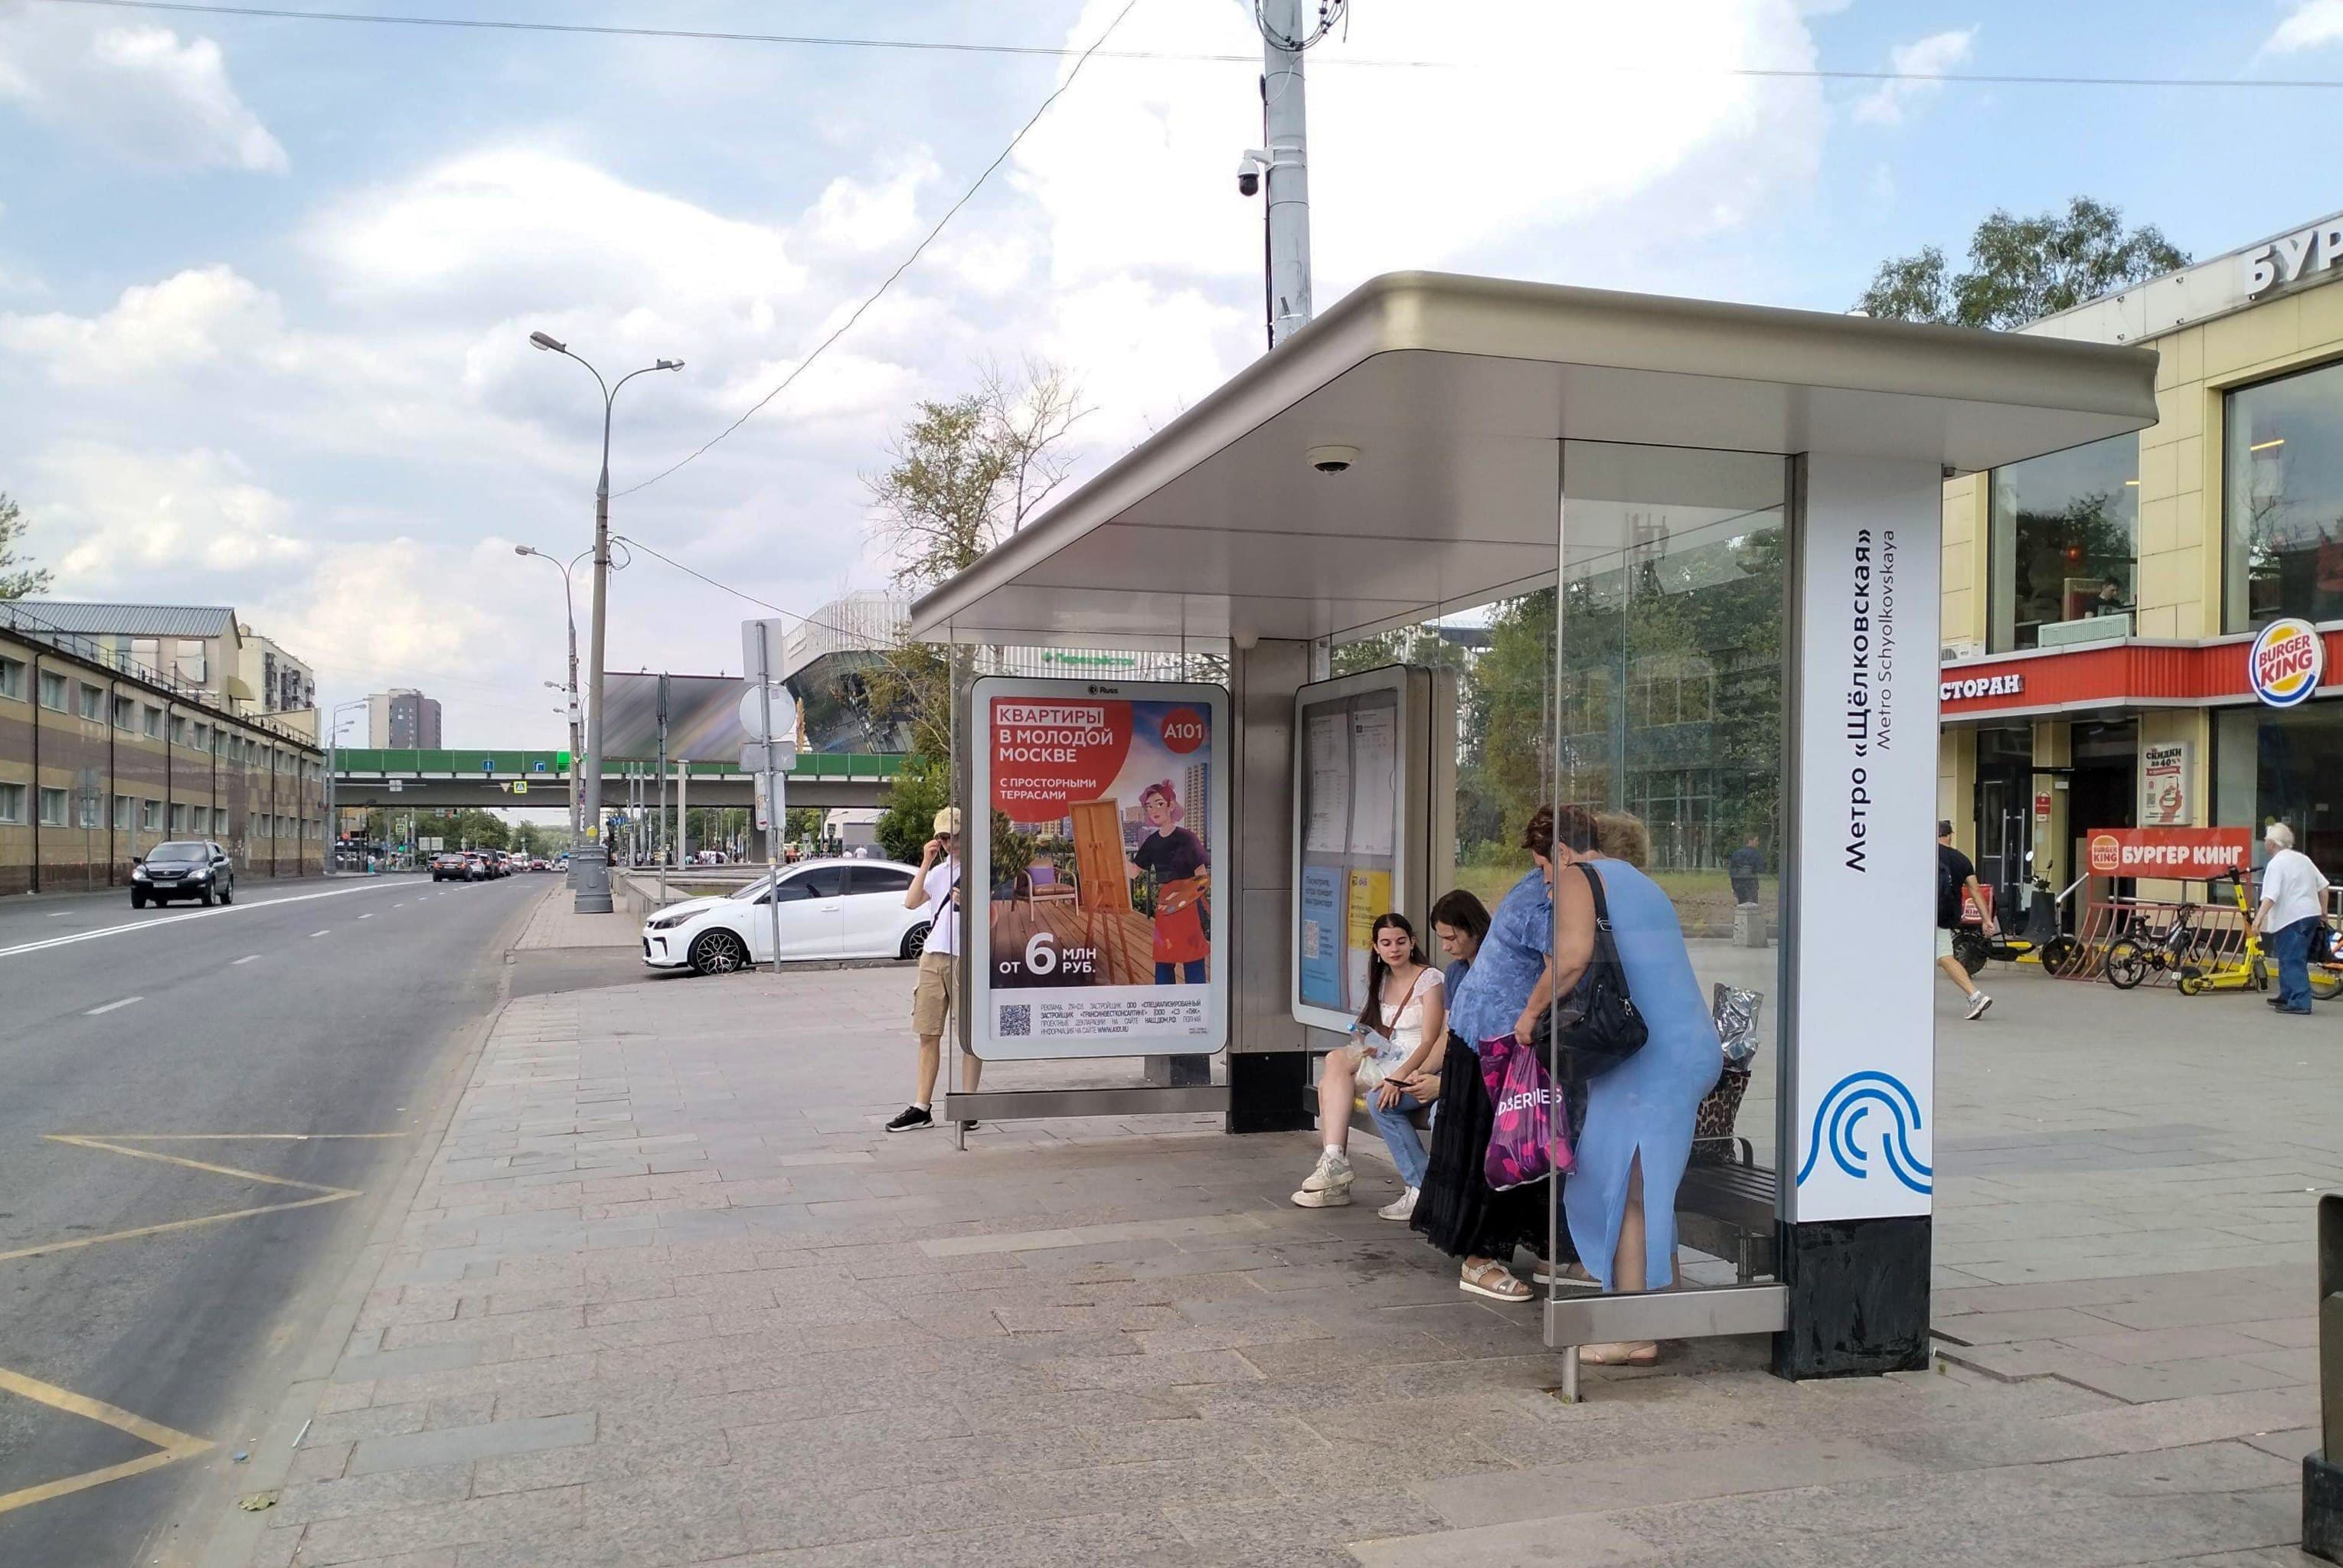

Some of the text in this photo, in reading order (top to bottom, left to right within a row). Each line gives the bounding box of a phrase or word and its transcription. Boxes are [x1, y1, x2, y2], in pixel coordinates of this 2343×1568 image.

[1877, 531, 1896, 750] Metro Schyolkovskaya
[2259, 635, 2311, 668] BURGER
[2261, 648, 2312, 688] KING
[1846, 529, 1871, 872] Метро «Щёлковская»
[999, 708, 1101, 724] КВАРТИРЫ
[1000, 728, 1113, 747] В МОЛОДОЙ
[1000, 747, 1077, 763] МОСКВЕ
[1000, 779, 1096, 788] С ПРОСТОРНЫМИ
[1000, 790, 1066, 800] ТЕРРАСАМИ
[2093, 853, 2117, 862] KING
[2122, 846, 2243, 864] БУРГЕР КИНГ
[999, 933, 1096, 975] ОТ 6 МЛН
[1063, 962, 1096, 973] РУБ.
